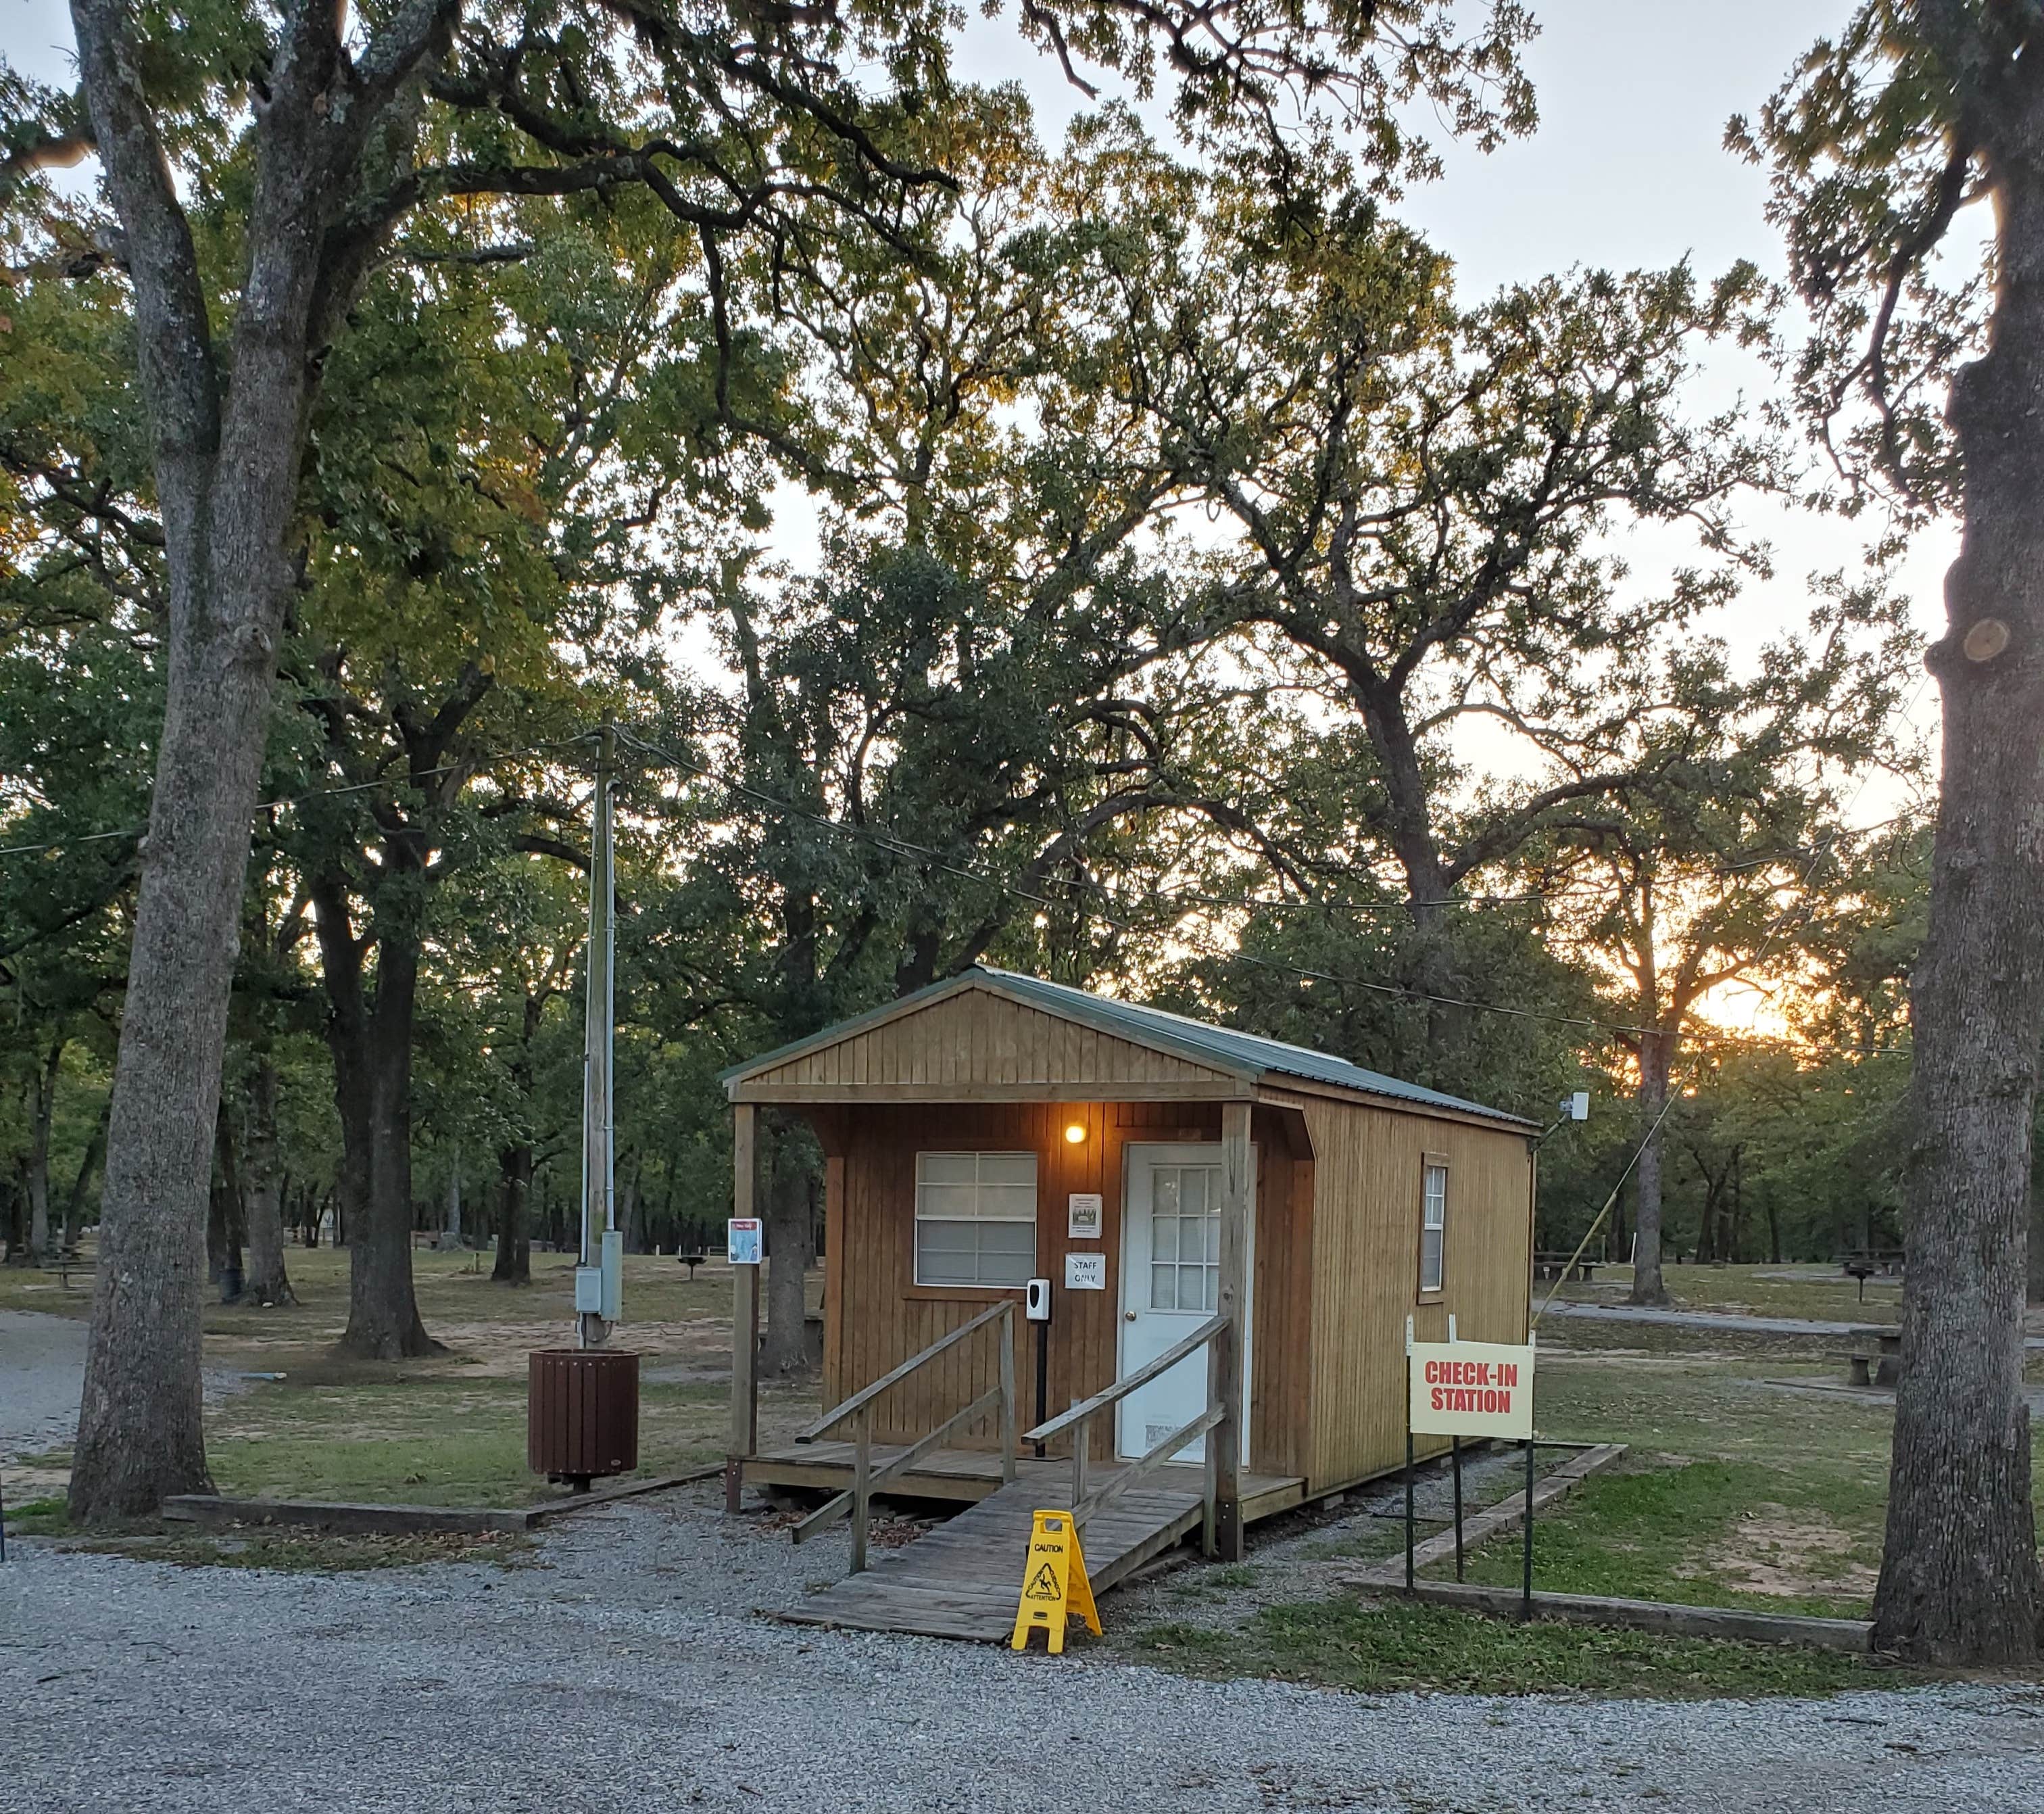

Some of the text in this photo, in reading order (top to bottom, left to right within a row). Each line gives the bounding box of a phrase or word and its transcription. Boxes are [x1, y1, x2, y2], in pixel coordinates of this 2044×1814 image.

[1425, 1360, 1517, 1387] CHECK-IN
[1431, 1387, 1510, 1413] STATION
[1034, 1544, 1063, 1553] CAUTION
